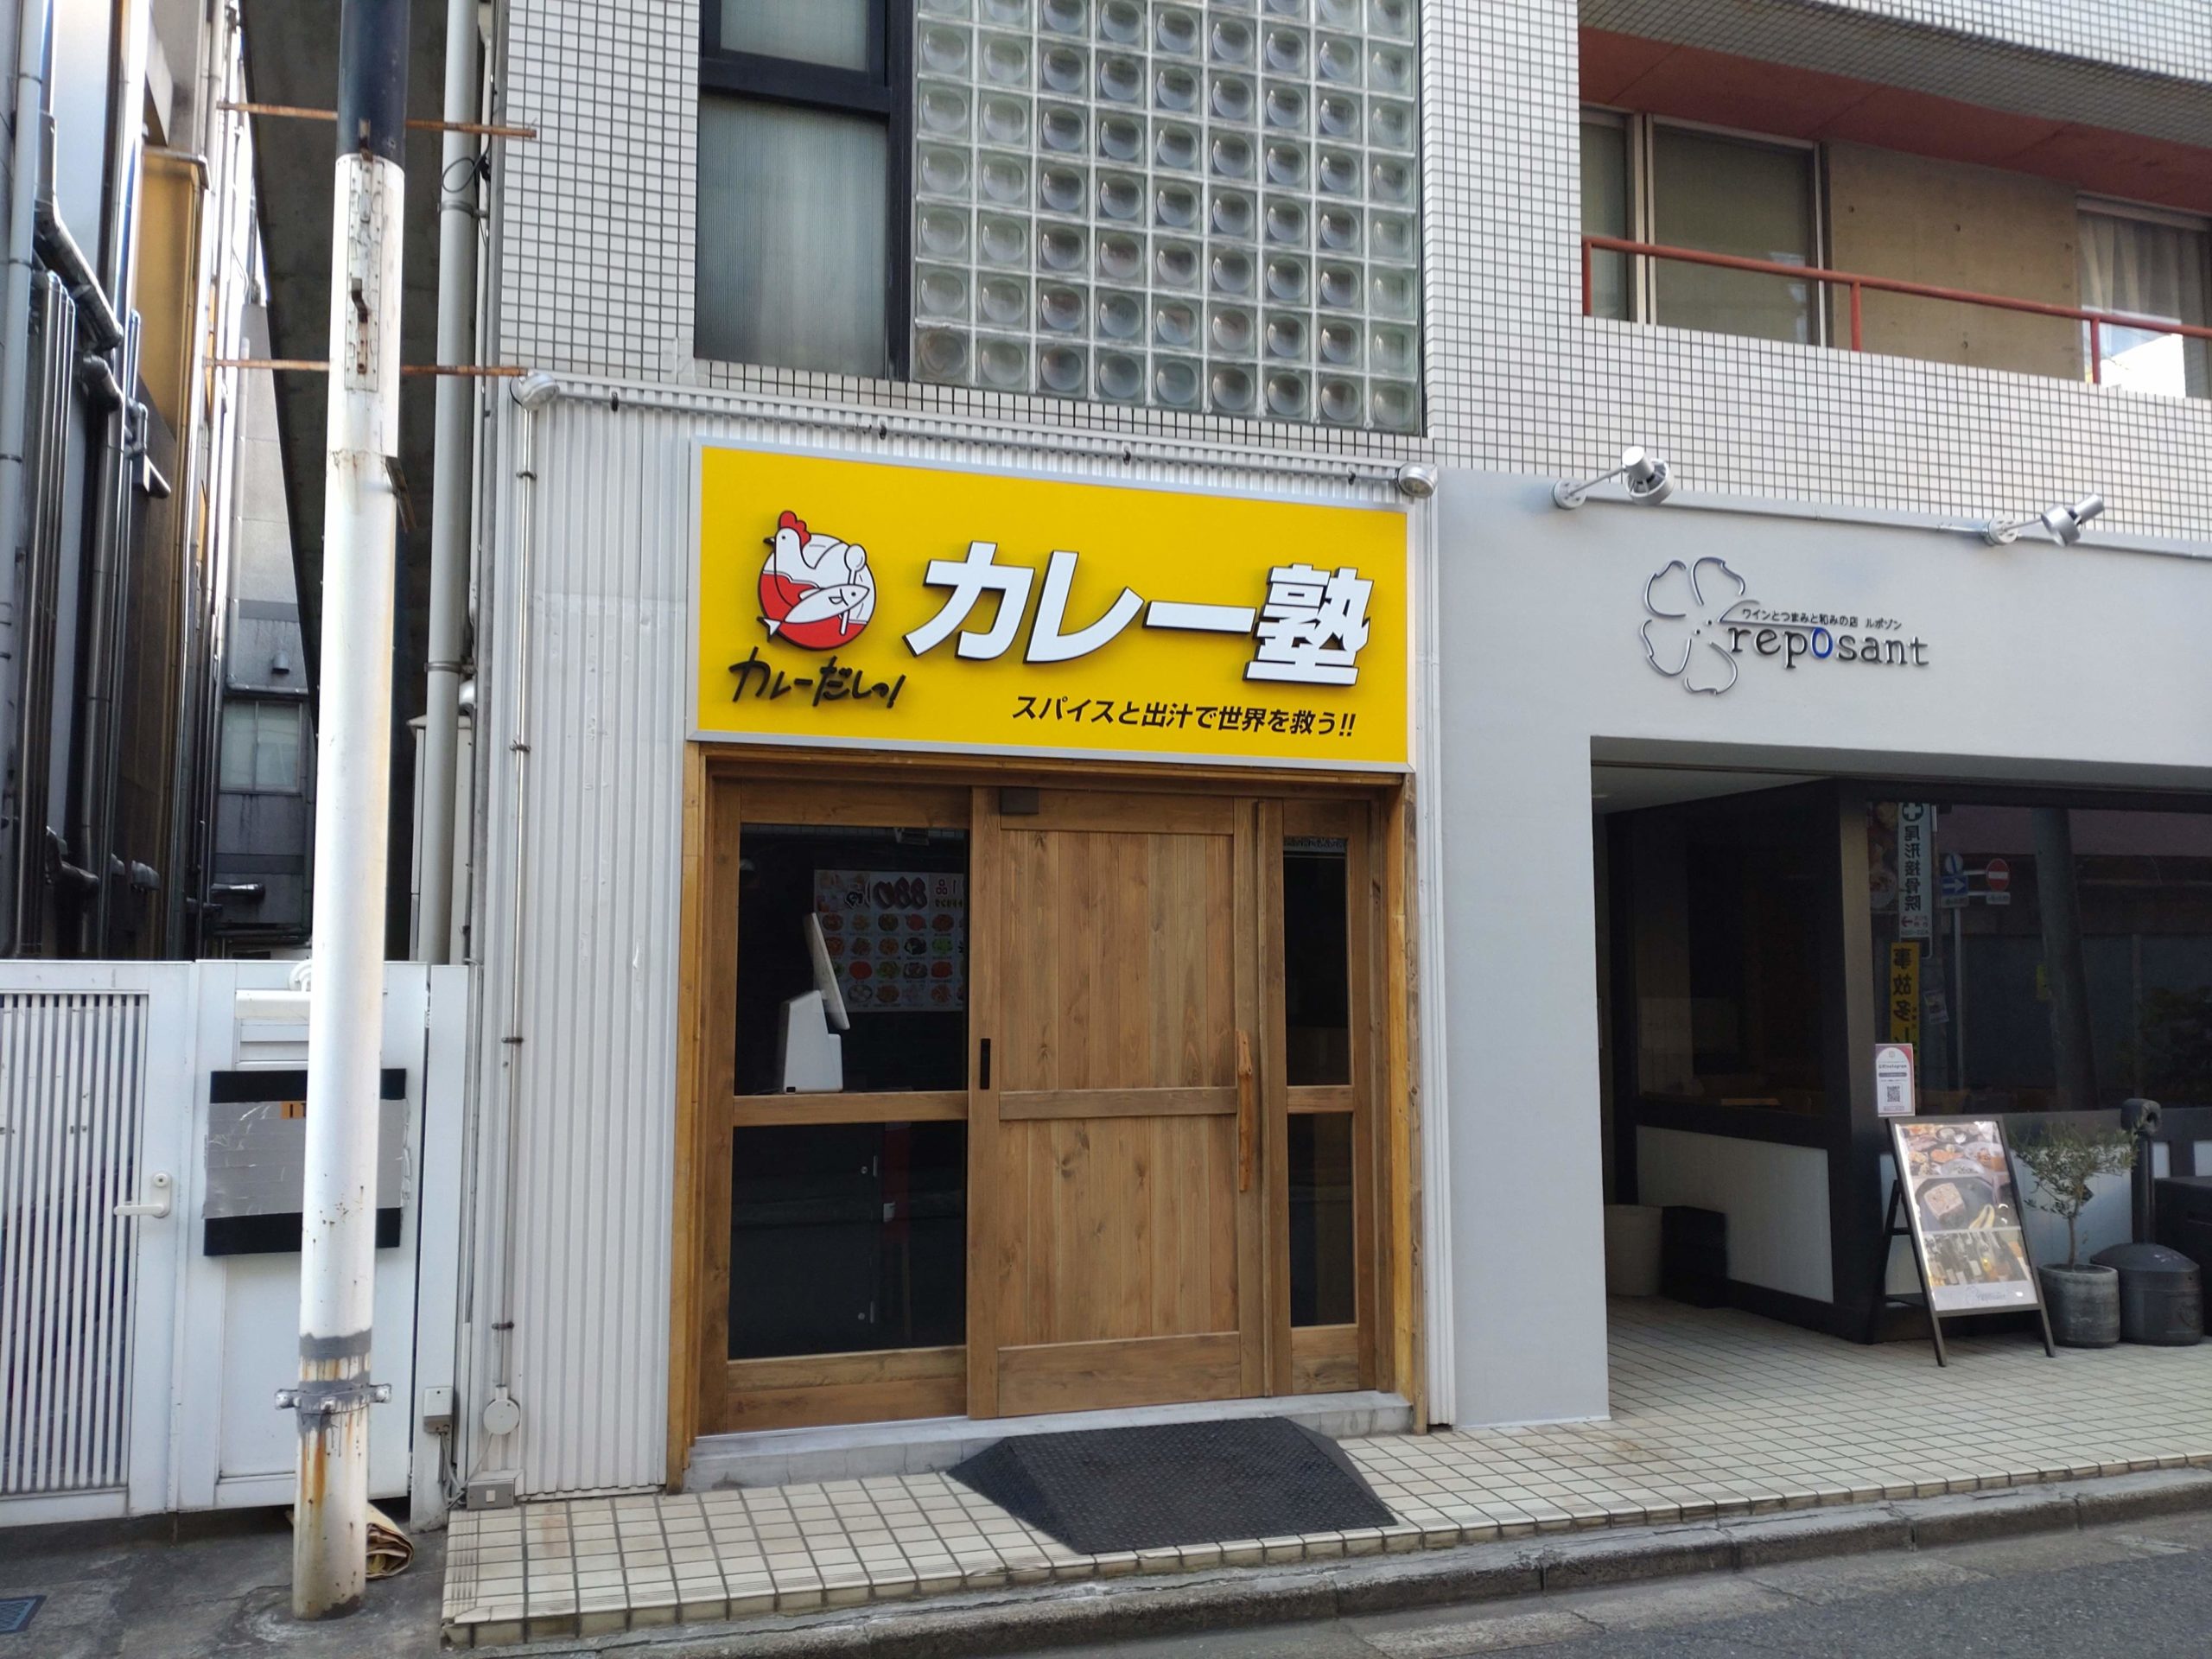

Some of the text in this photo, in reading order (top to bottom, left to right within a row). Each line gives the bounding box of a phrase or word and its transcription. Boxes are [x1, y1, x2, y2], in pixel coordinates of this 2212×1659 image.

[903, 540, 1375, 685] カレー塾
[1743, 608, 1859, 627] ワインとつまみと和みの店
